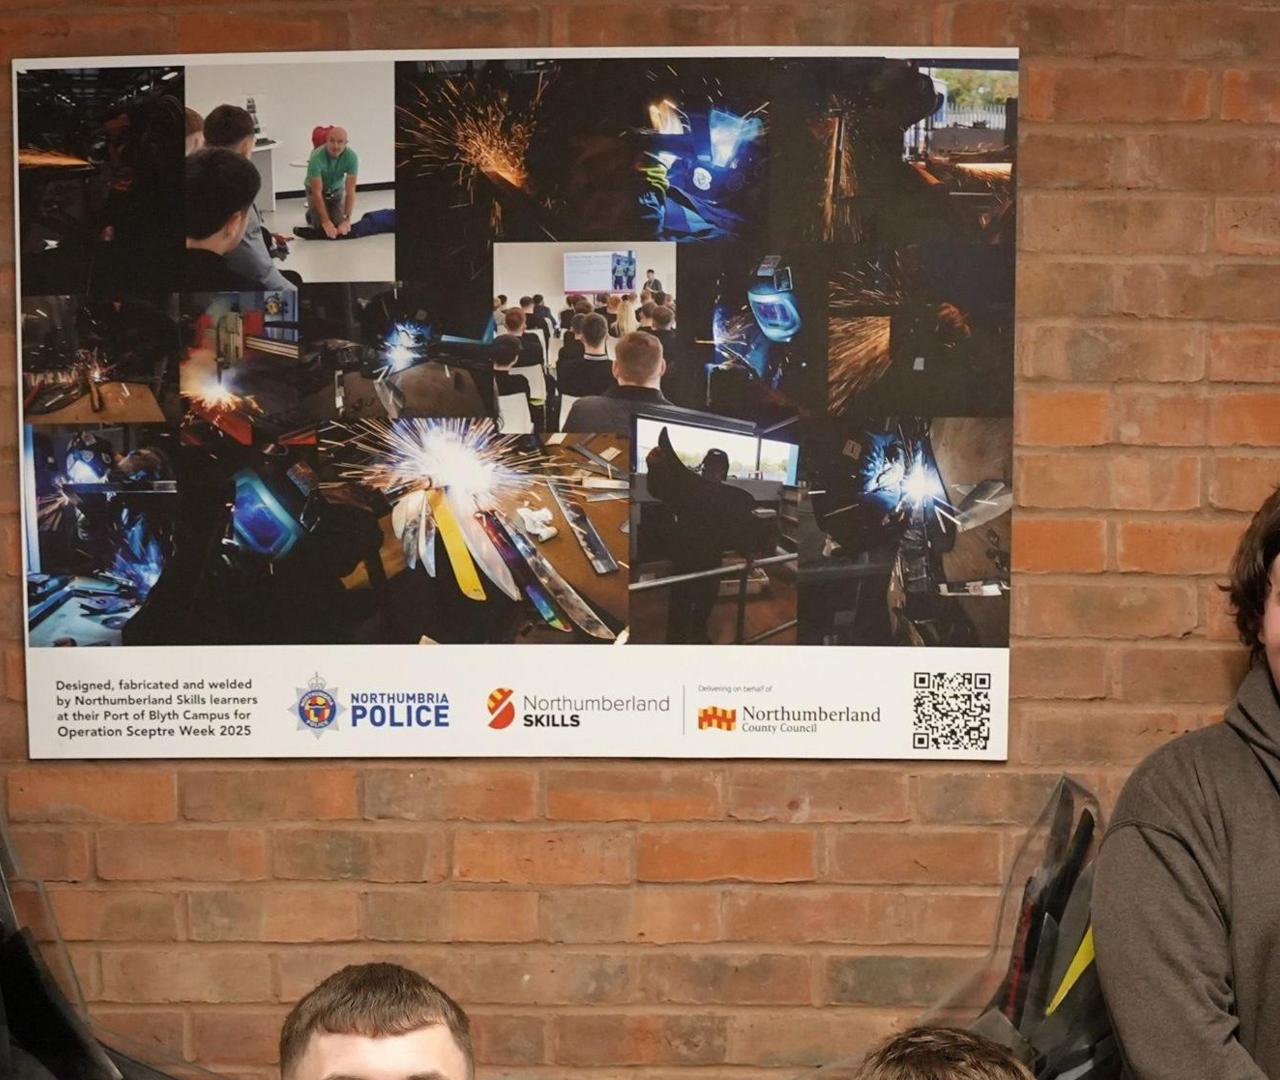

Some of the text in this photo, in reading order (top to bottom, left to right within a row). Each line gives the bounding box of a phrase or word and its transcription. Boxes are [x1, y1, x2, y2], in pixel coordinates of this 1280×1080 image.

[56, 679, 252, 693] Designed, fabricated and welded
[698, 684, 732, 694] Delivering
[743, 685, 764, 693] behalf
[56, 694, 258, 708] by Northumberland Skills learners
[351, 693, 449, 704] NORTHUMBRIA
[523, 695, 670, 712] Northumberland
[57, 710, 251, 723] at their Port of Blyth Campus for
[351, 705, 449, 727] POLICE
[523, 714, 580, 727] SKILLS
[742, 706, 881, 722] Northumberland
[57, 725, 252, 739] Operation Sceptre Week 2025
[742, 723, 817, 735] County Council
